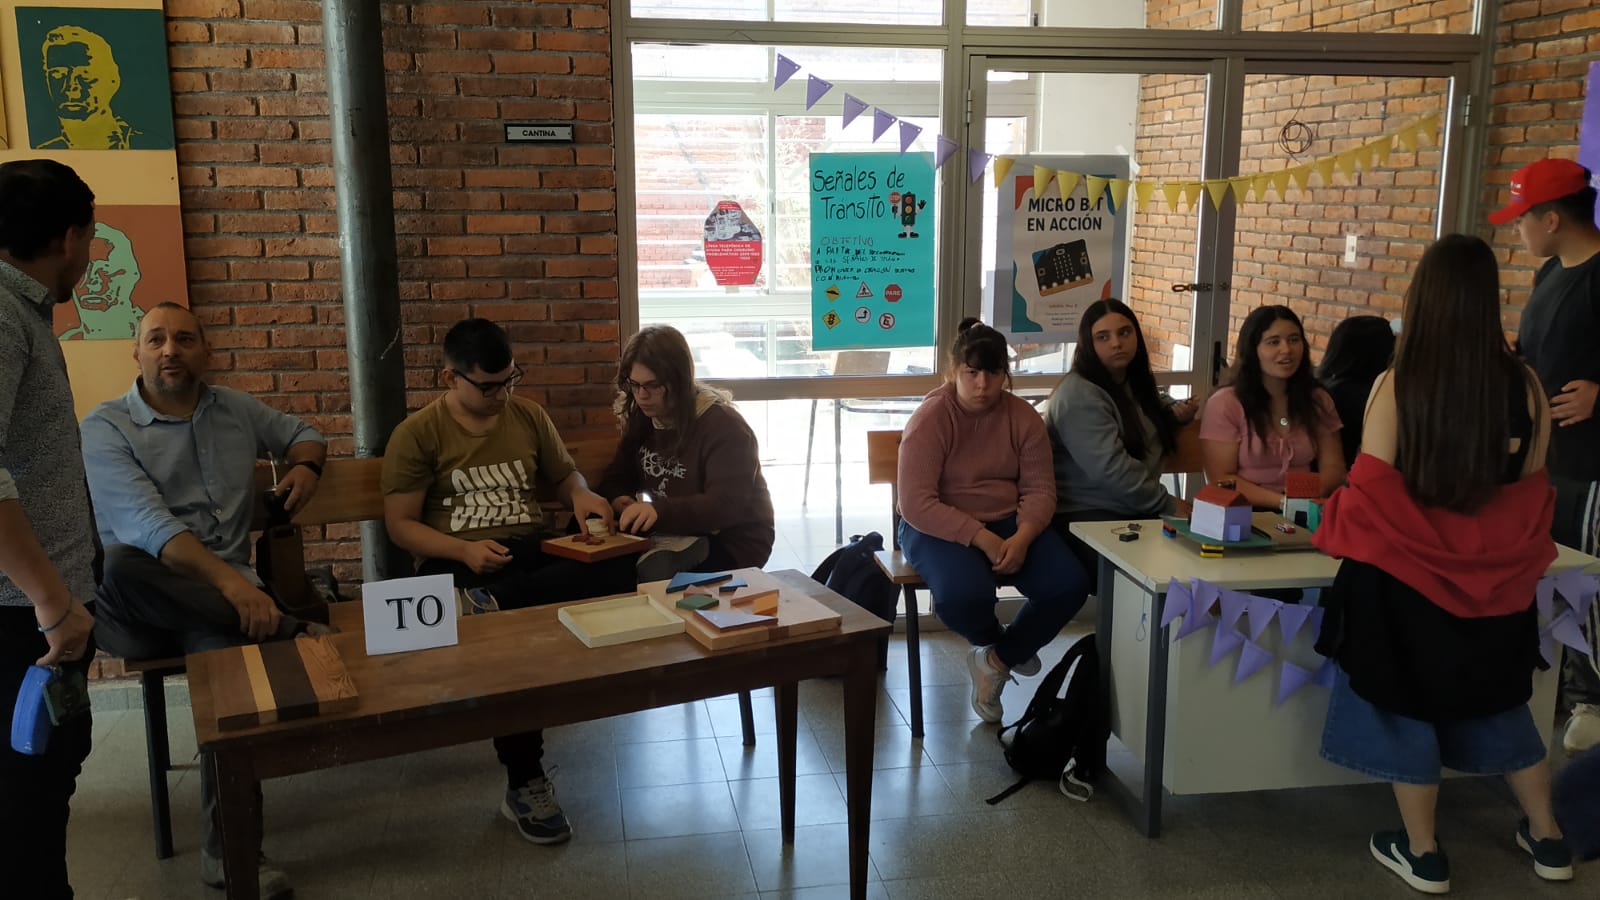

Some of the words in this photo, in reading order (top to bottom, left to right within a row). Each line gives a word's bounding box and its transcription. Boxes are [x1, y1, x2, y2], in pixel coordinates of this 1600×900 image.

[813, 165, 877, 192] Señales
[887, 164, 905, 188] de
[1028, 197, 1075, 212] MICRO
[1027, 217, 1045, 231] EN
[1049, 213, 1102, 231] ACCIÓN
[385, 594, 443, 630] TO
